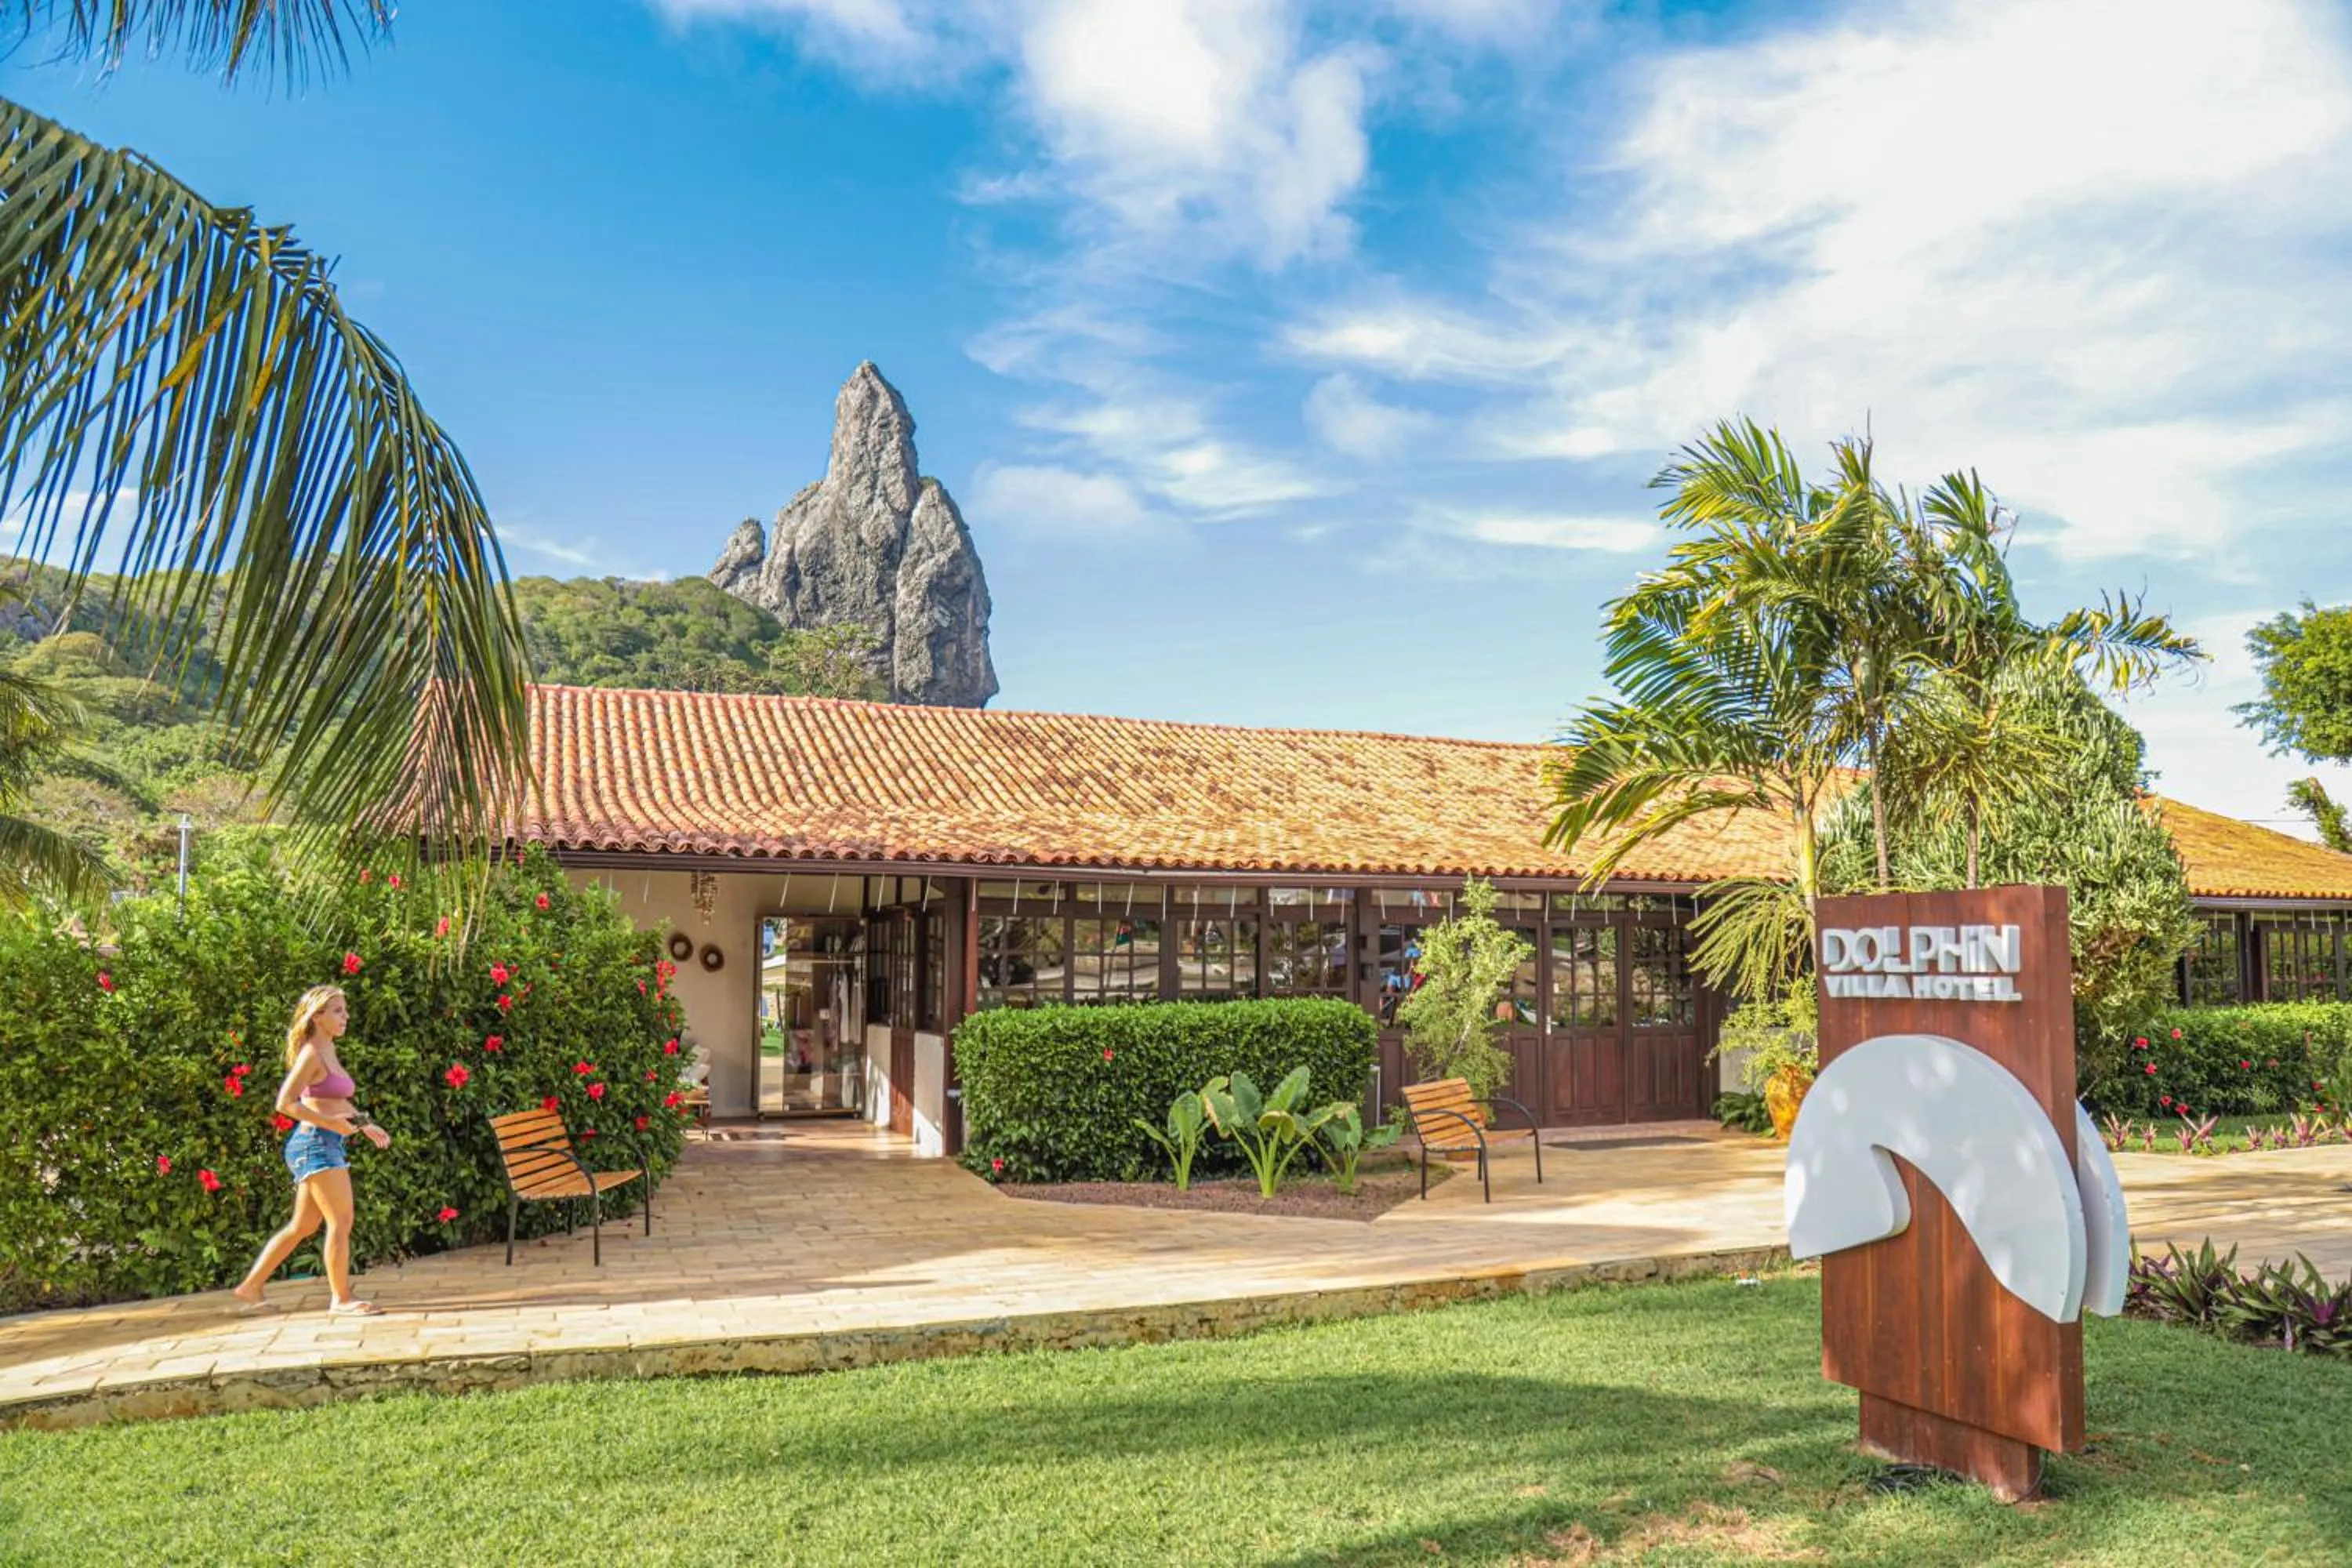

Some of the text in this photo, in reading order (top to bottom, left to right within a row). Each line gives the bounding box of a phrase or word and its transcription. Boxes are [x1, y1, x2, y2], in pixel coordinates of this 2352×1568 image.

[1822, 925, 2020, 973] DOLPHIN
[1824, 975, 2023, 1001] VILLA HOTEL
